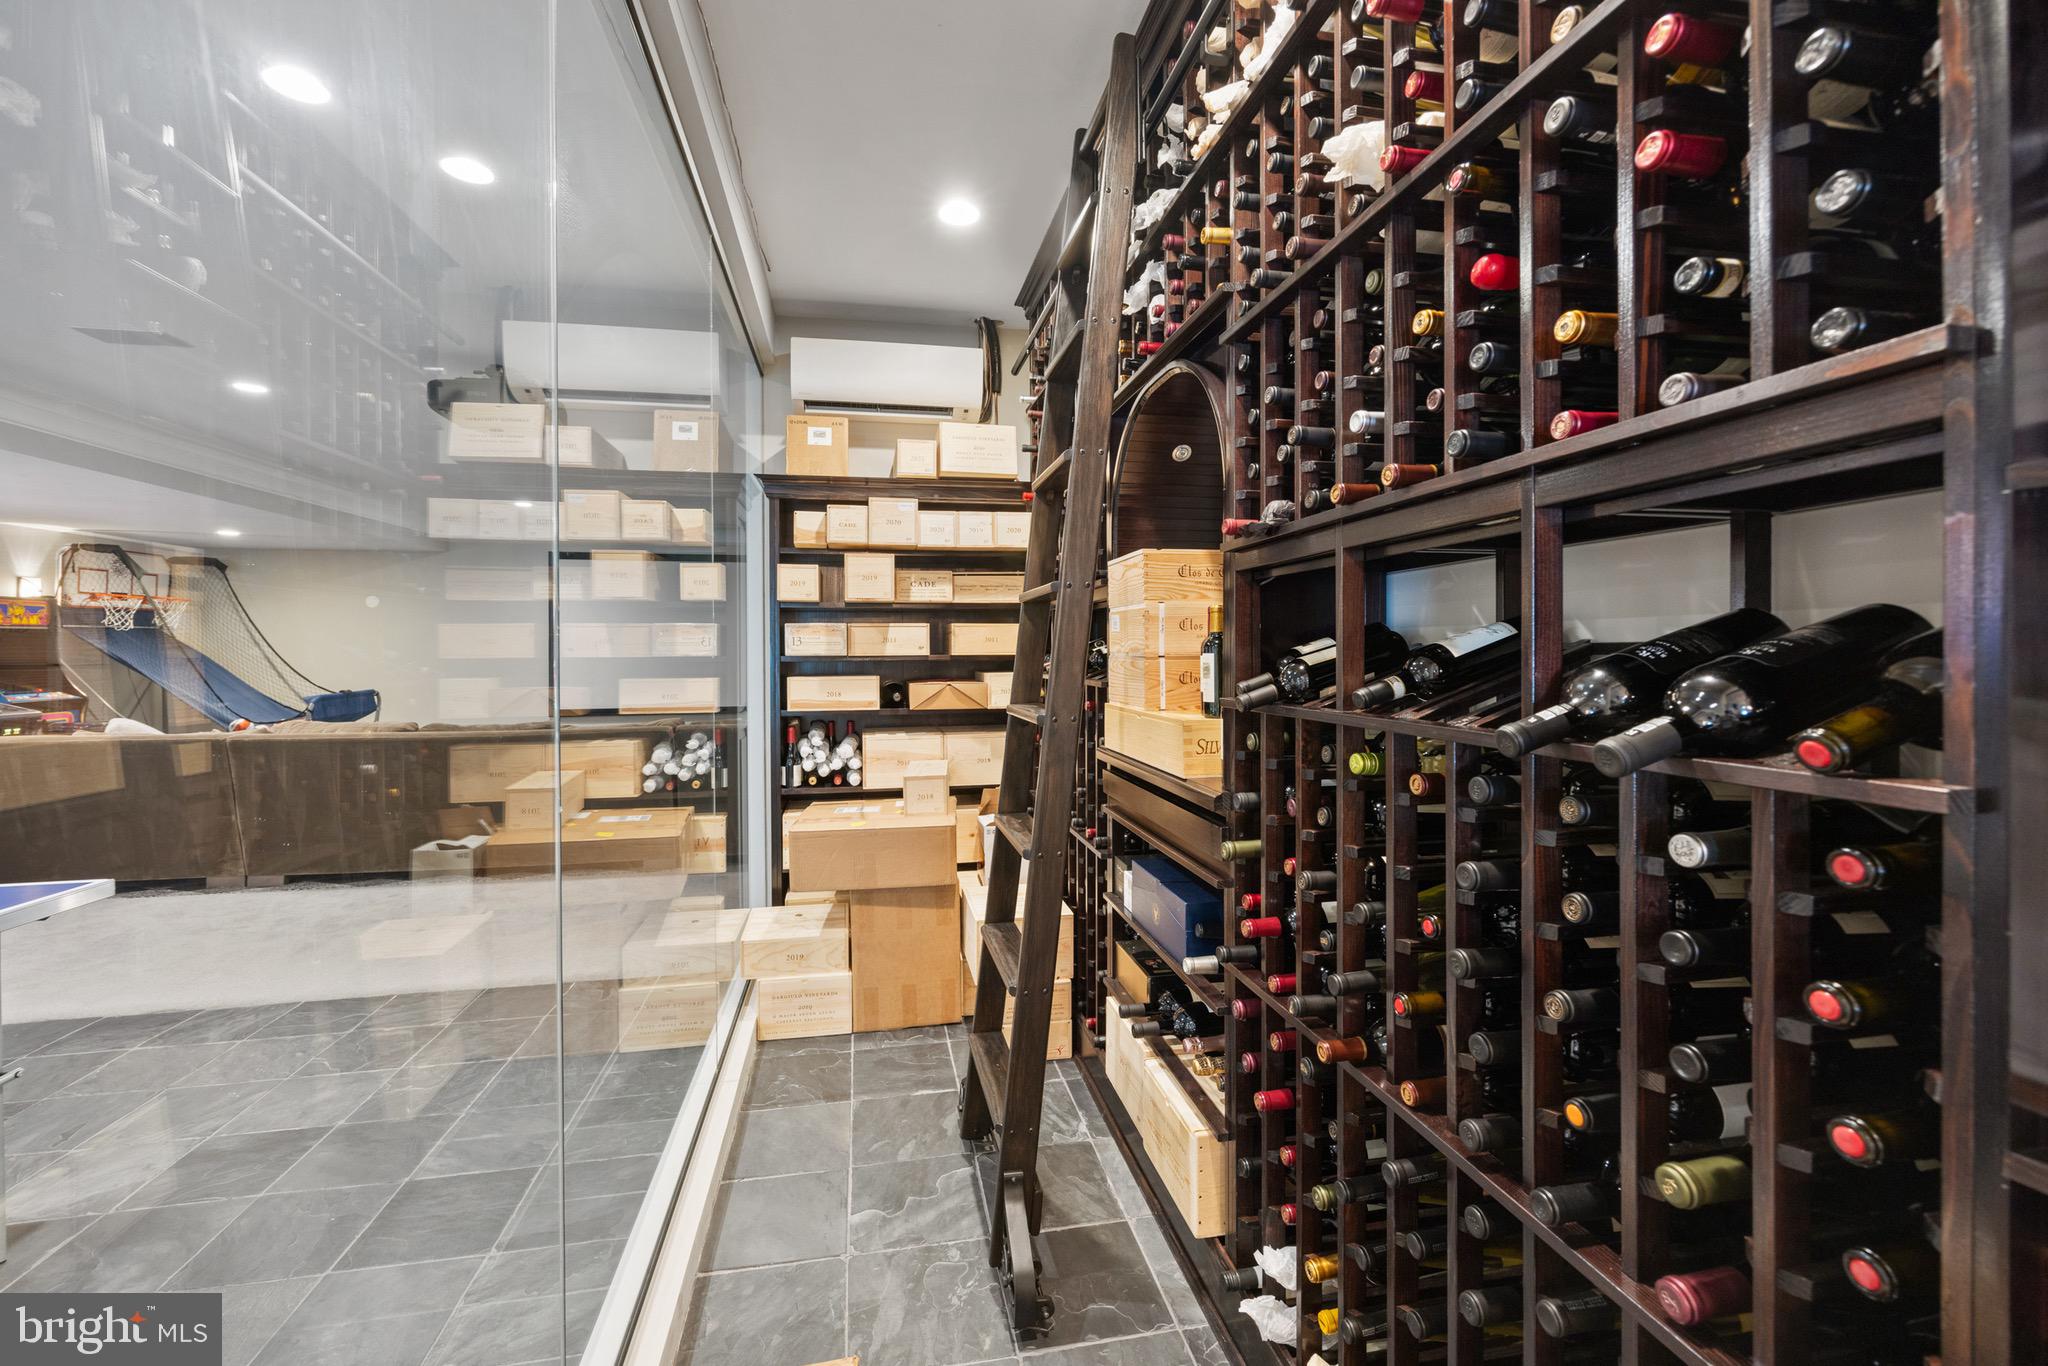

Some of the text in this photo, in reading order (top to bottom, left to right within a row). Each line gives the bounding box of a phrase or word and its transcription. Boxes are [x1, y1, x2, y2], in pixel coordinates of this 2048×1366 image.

[1177, 564, 1202, 578] Clos
[910, 580, 937, 588] CADE
[1178, 617, 1204, 631] Clos
[786, 953, 804, 961] 2019
